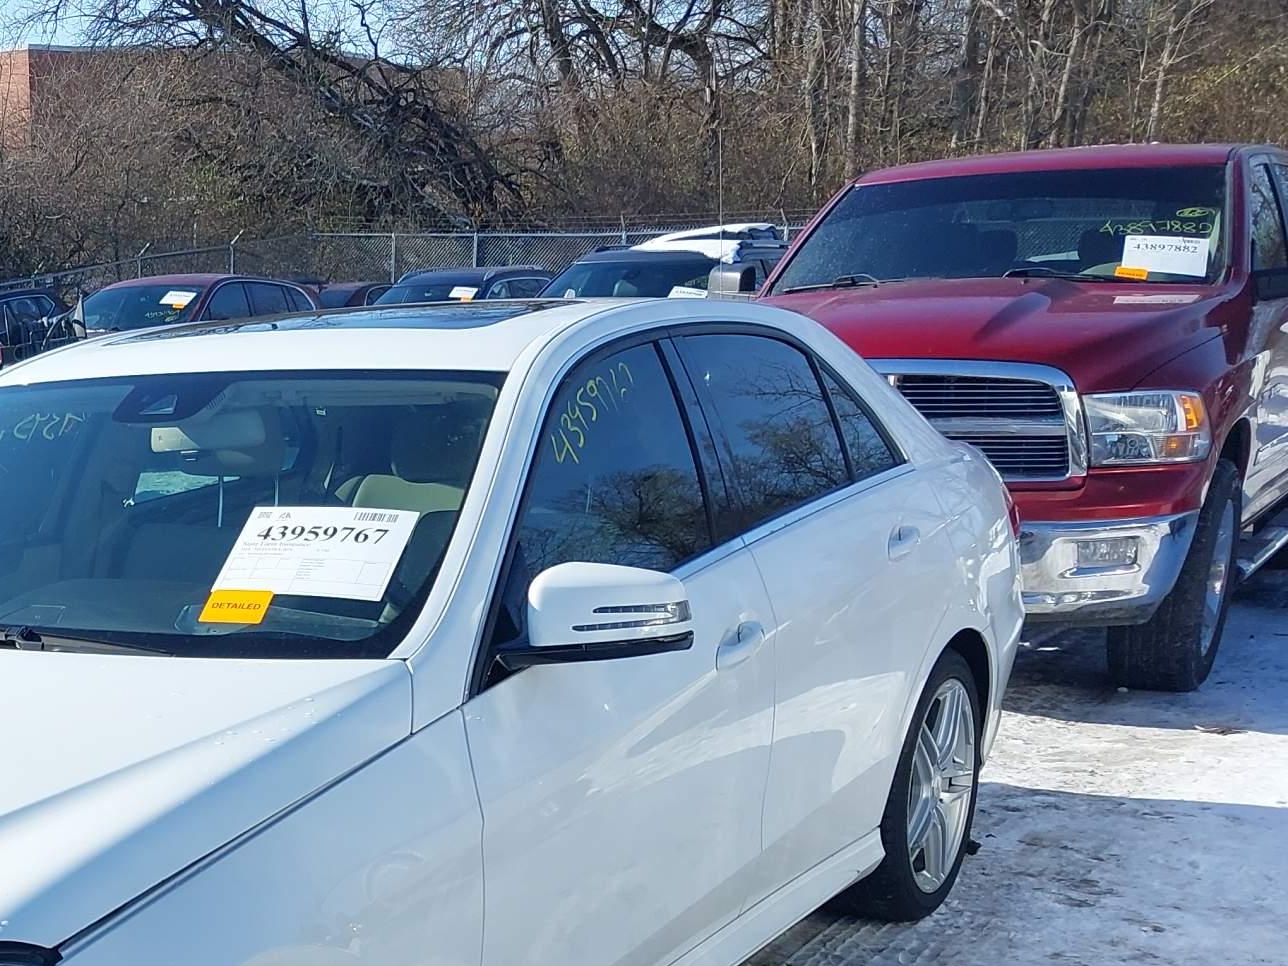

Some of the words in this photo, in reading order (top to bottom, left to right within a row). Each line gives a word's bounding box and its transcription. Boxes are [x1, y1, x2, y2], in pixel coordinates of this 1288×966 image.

[1132, 243, 1198, 254] 43897882
[257, 525, 390, 545] 43959767
[211, 602, 262, 611] DETAILED
